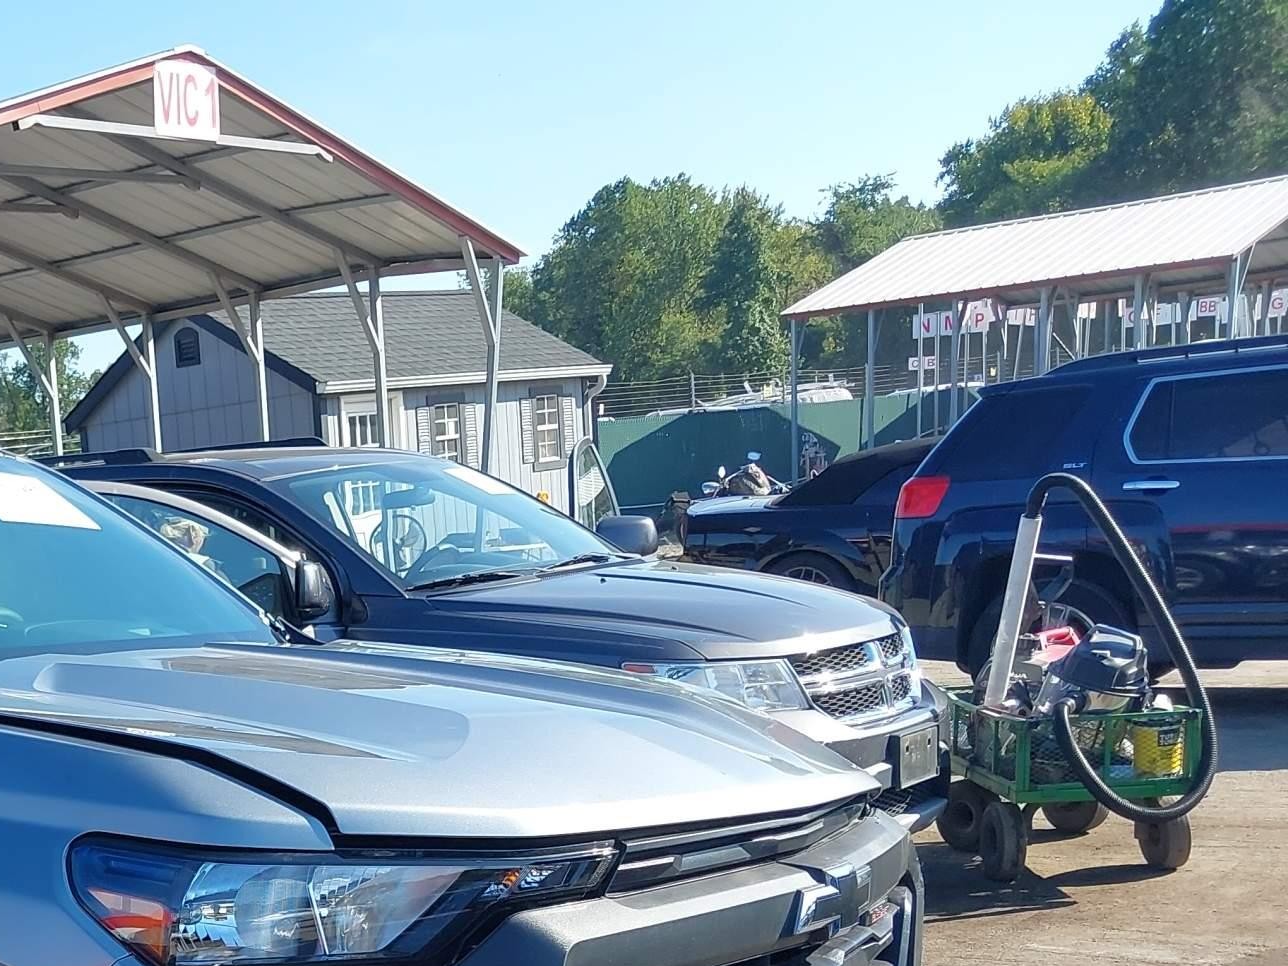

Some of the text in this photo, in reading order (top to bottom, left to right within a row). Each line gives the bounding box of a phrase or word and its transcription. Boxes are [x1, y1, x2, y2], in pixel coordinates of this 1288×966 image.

[158, 71, 217, 128] VIC 1
[1271, 297, 1284, 310] G
[976, 313, 984, 328] P
